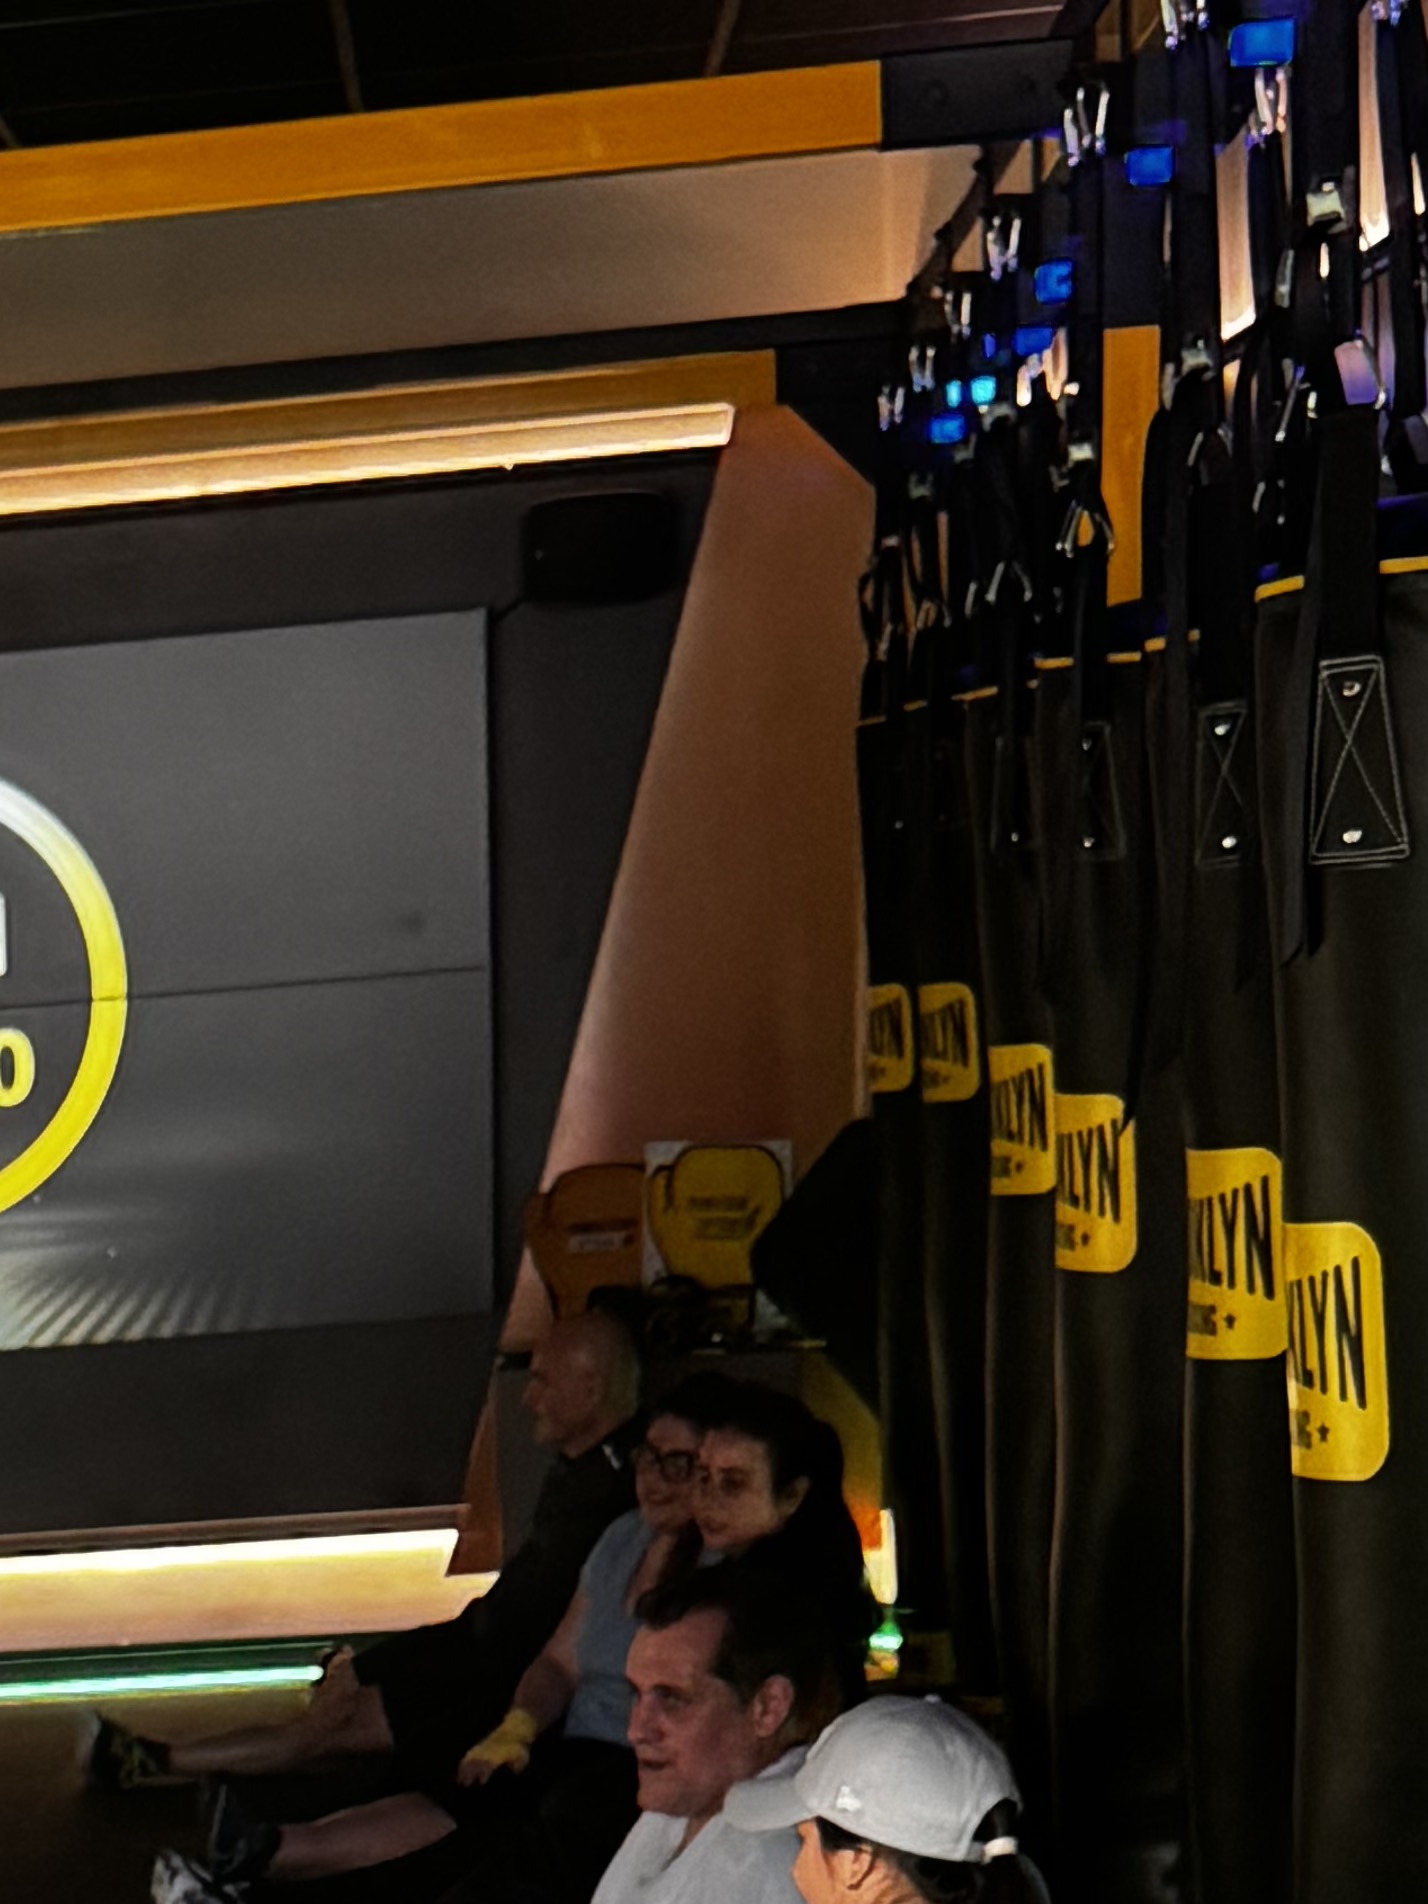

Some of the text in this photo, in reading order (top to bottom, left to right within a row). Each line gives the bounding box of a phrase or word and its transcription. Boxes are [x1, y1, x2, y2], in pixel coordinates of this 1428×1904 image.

[992, 1062, 1048, 1153] LYN
[1055, 1117, 1121, 1225] LYN
[1188, 1174, 1275, 1301] LYN
[1287, 1256, 1367, 1411] LYN
